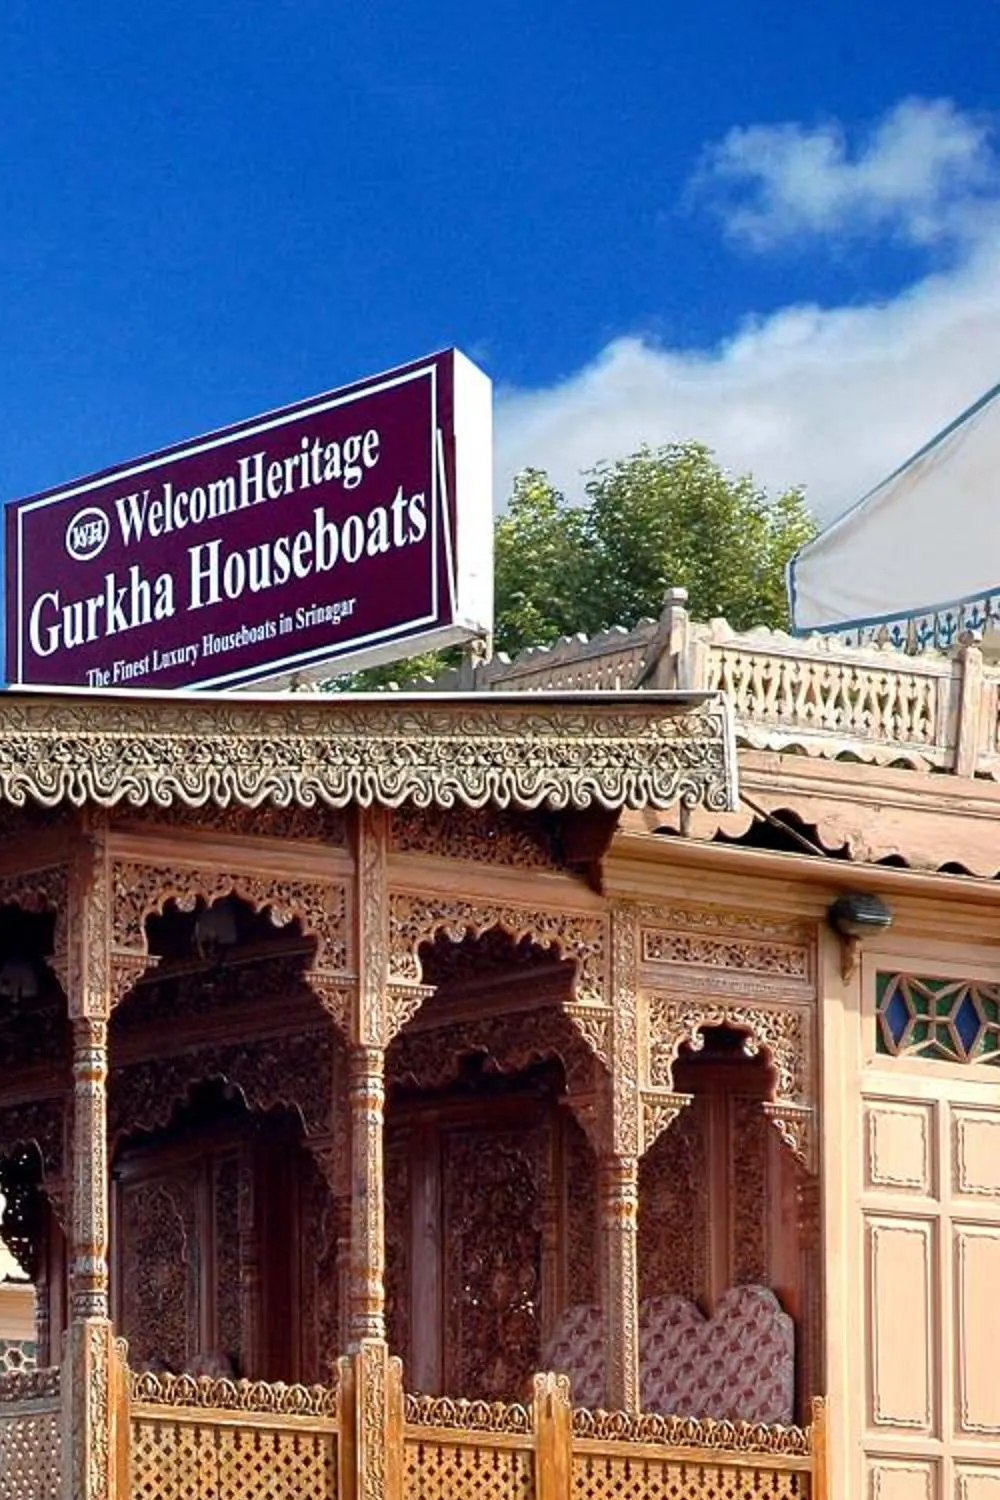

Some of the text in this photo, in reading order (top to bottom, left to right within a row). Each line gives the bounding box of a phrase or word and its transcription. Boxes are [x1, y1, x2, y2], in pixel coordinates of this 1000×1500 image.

[115, 428, 380, 547] WelcomHeritage
[29, 484, 427, 657] Gurkha Houseboats
[85, 598, 357, 690] The Finest Luxury Houseboats in Srinagar
